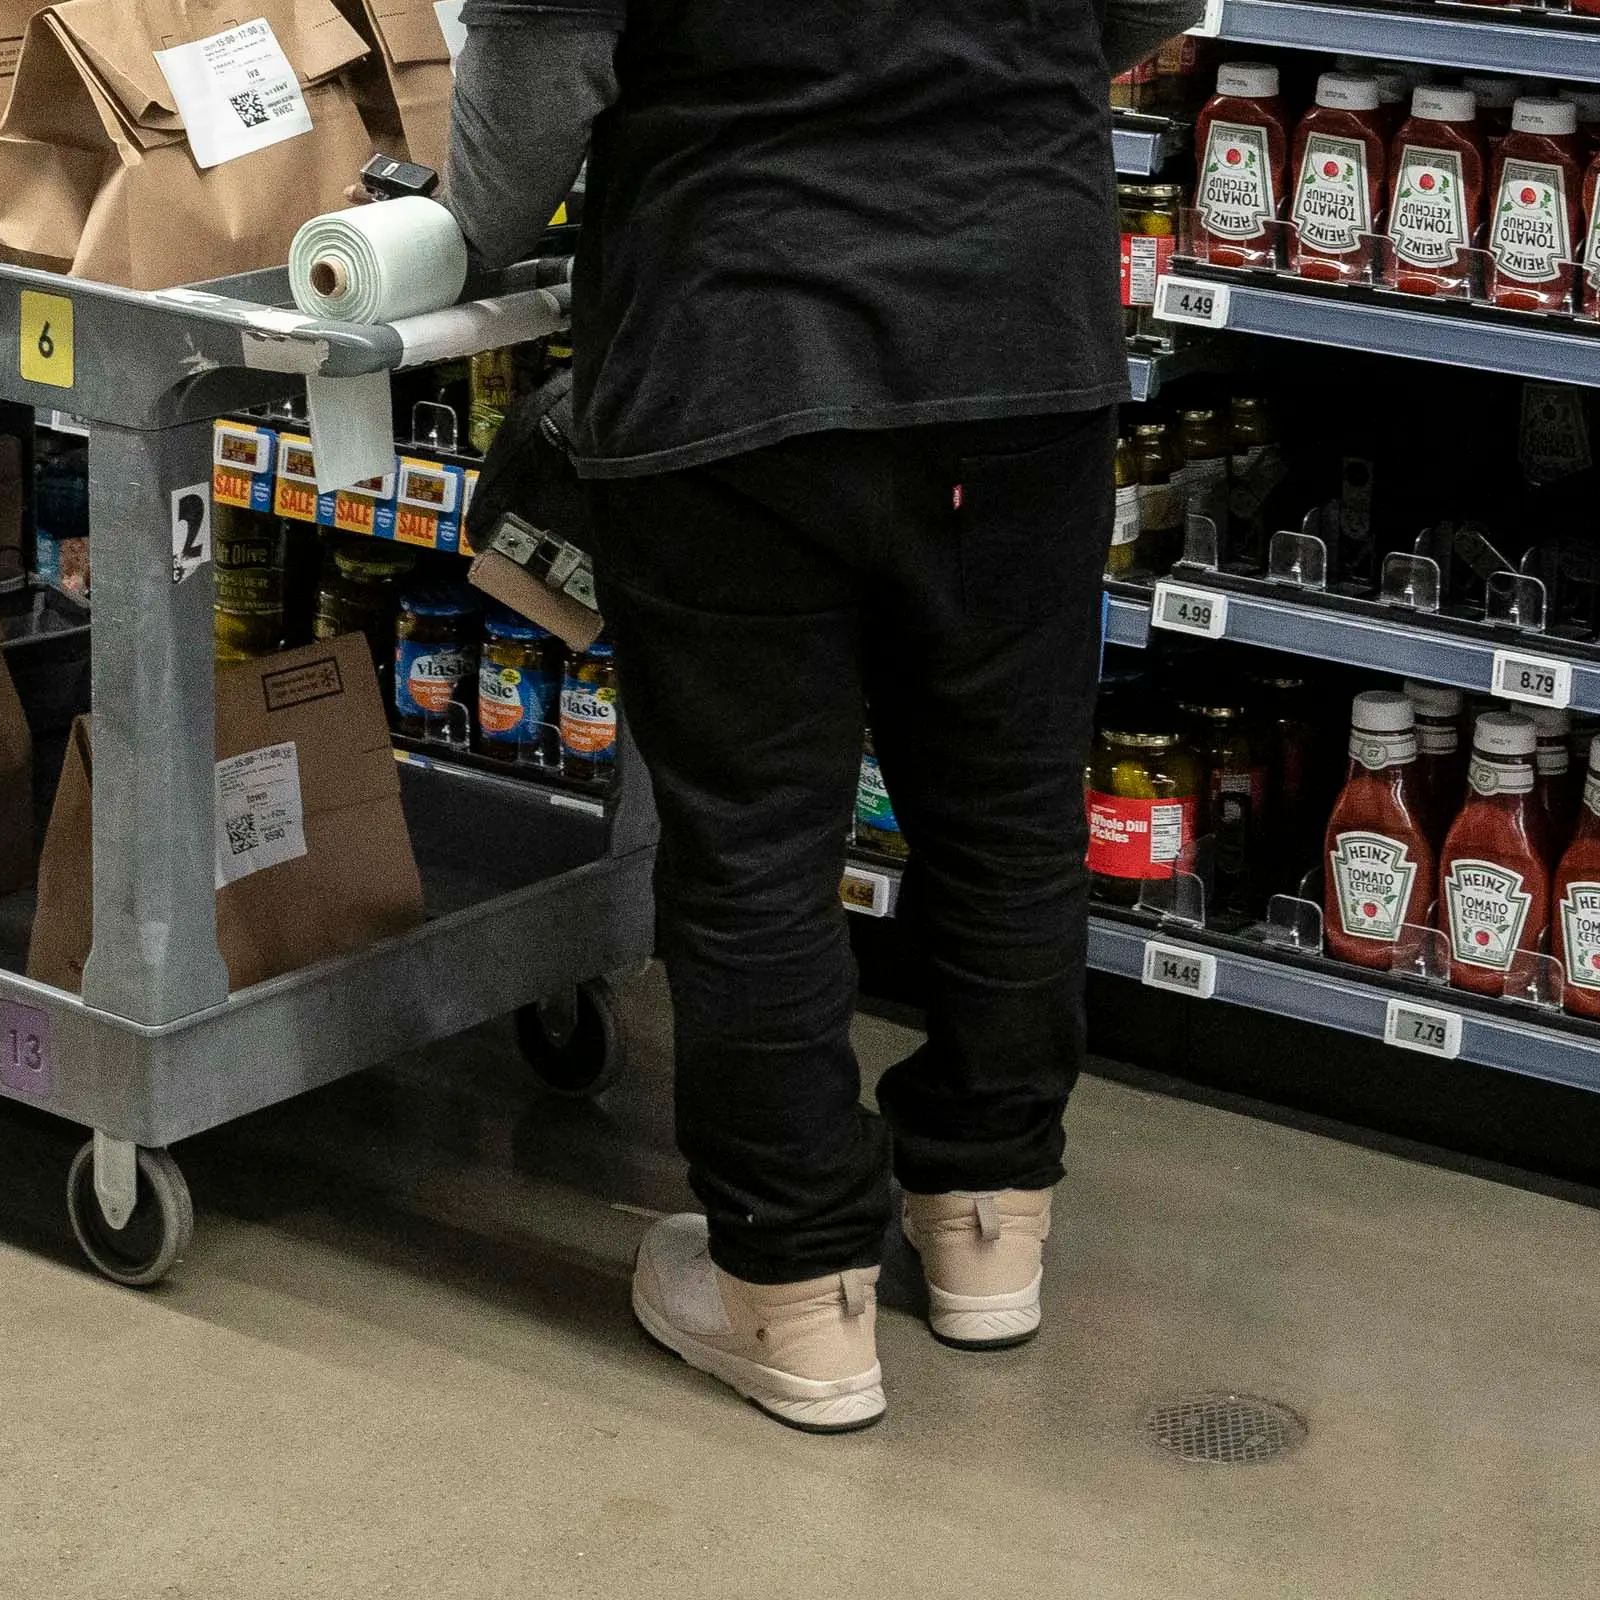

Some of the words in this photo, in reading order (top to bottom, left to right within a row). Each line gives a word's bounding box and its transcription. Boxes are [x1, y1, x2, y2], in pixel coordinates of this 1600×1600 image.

[37, 321, 55, 358] 6
[176, 492, 202, 559] 2
[1520, 672, 1555, 694] 8.79
[1125, 817, 1148, 832] Dill
[1348, 845, 1391, 863] HEINZ
[1347, 869, 1395, 886] TOMATO
[1350, 883, 1393, 896] KETCHUP
[1161, 958, 1200, 981] 14.49
[8, 1027, 44, 1071] 13
